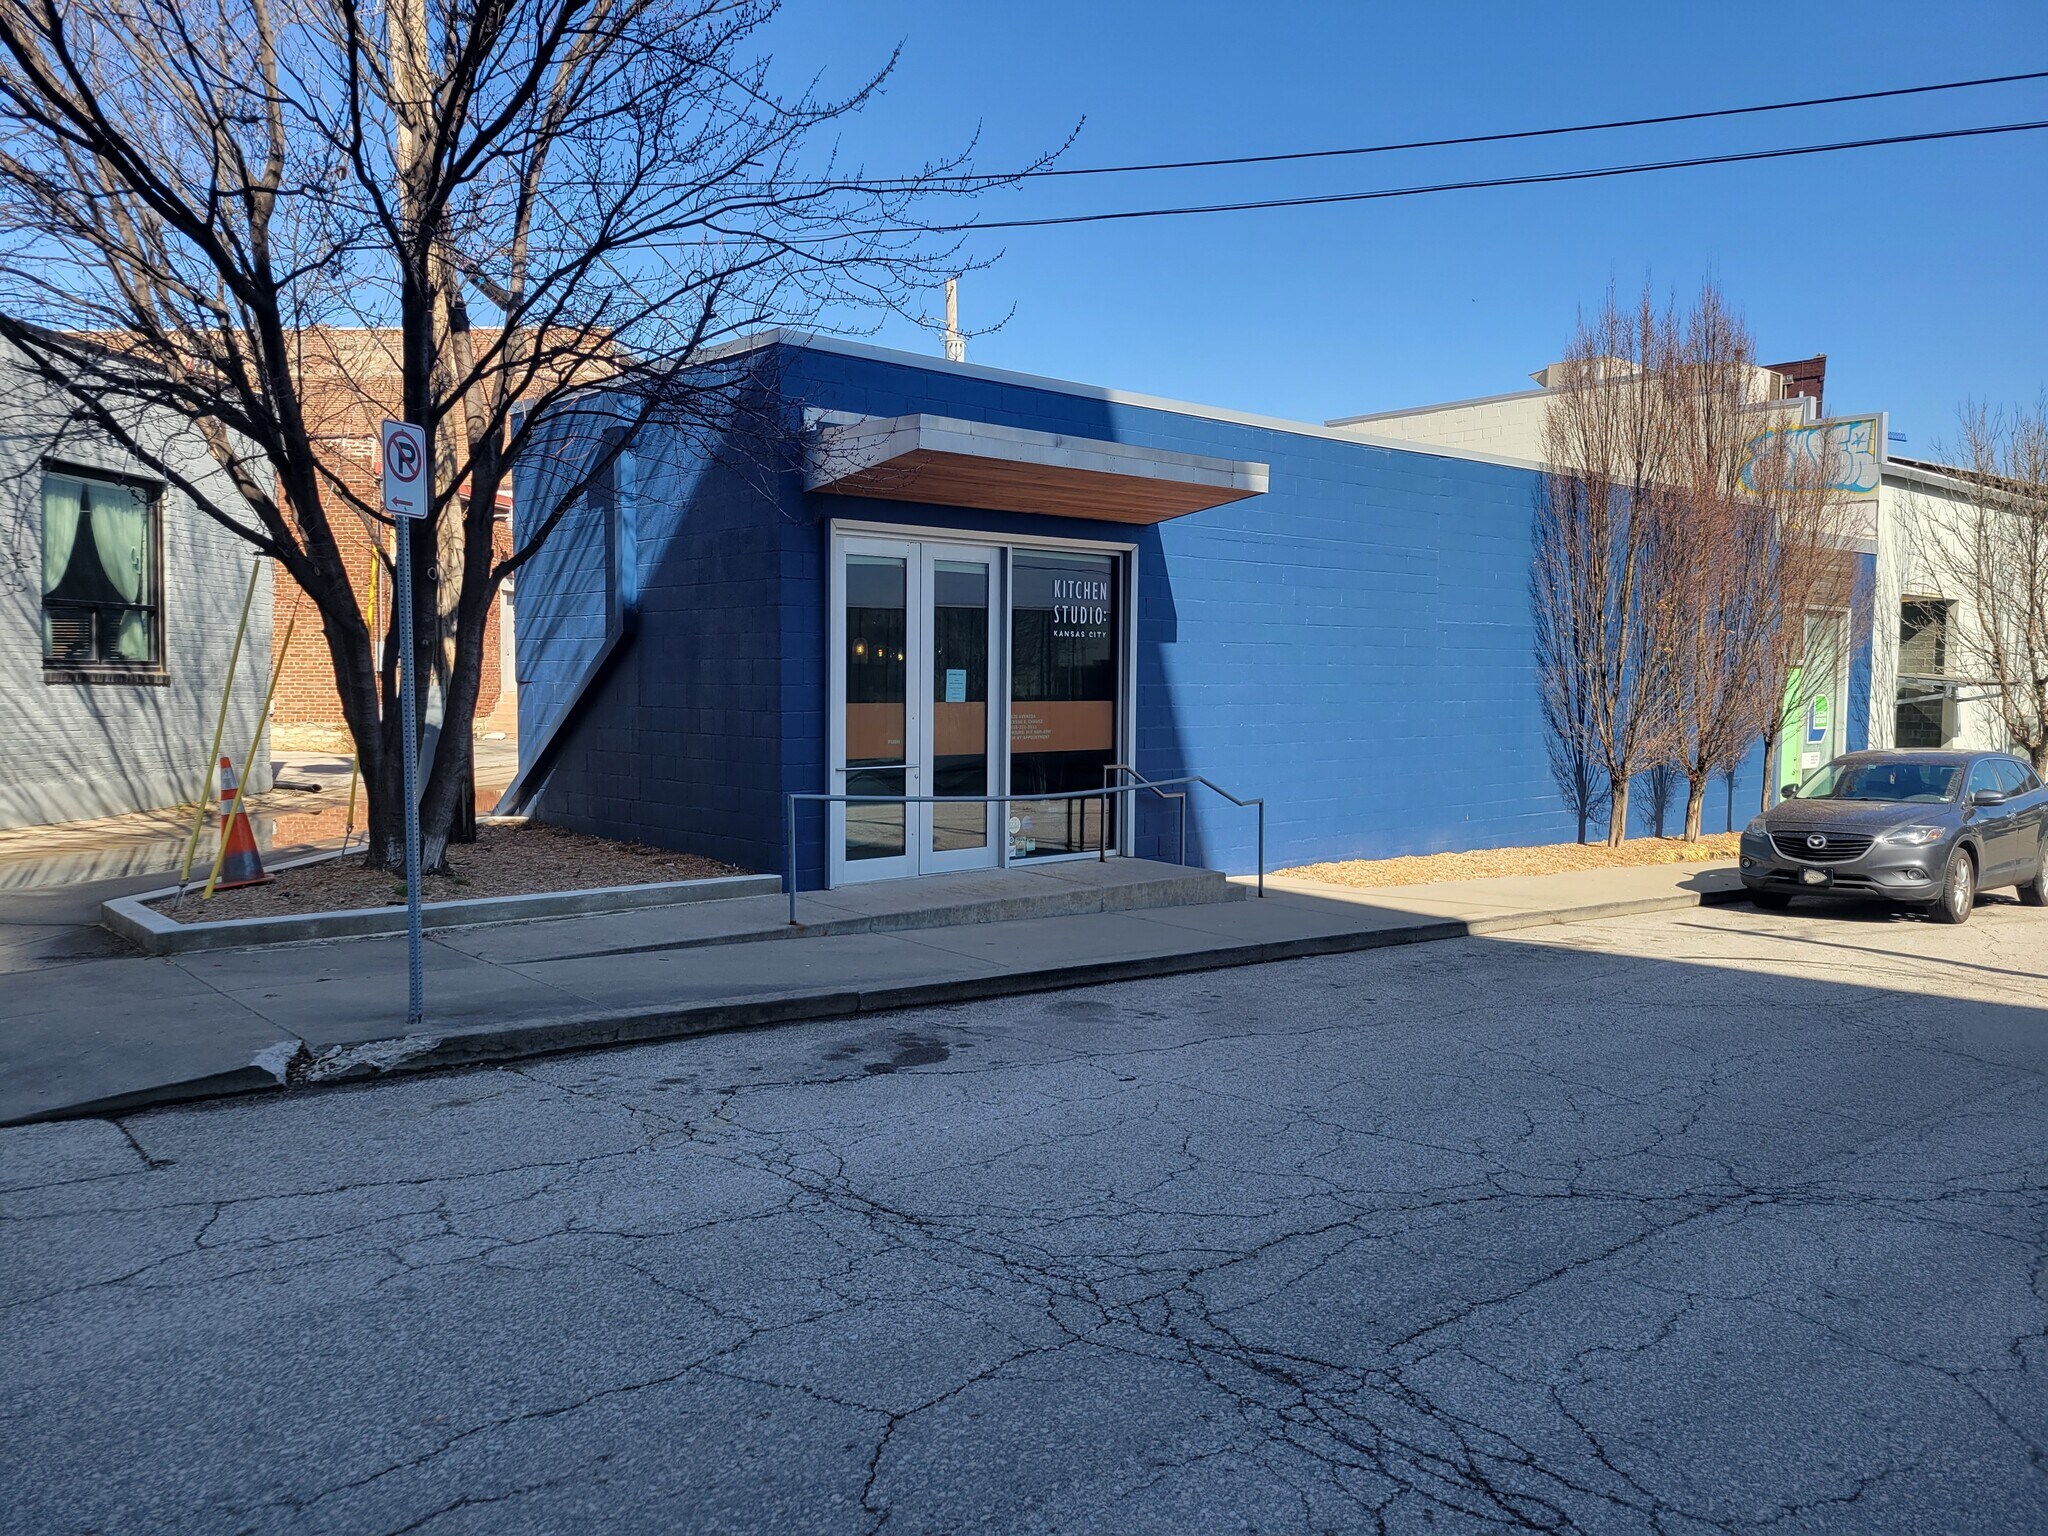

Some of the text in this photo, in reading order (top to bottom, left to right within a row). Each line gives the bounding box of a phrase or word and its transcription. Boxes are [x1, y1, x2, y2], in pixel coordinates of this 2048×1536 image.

[1054, 579, 1107, 600] KITCHEN
[1053, 605, 1107, 625] STUDIO:
[1053, 630, 1085, 638] KANSAS
